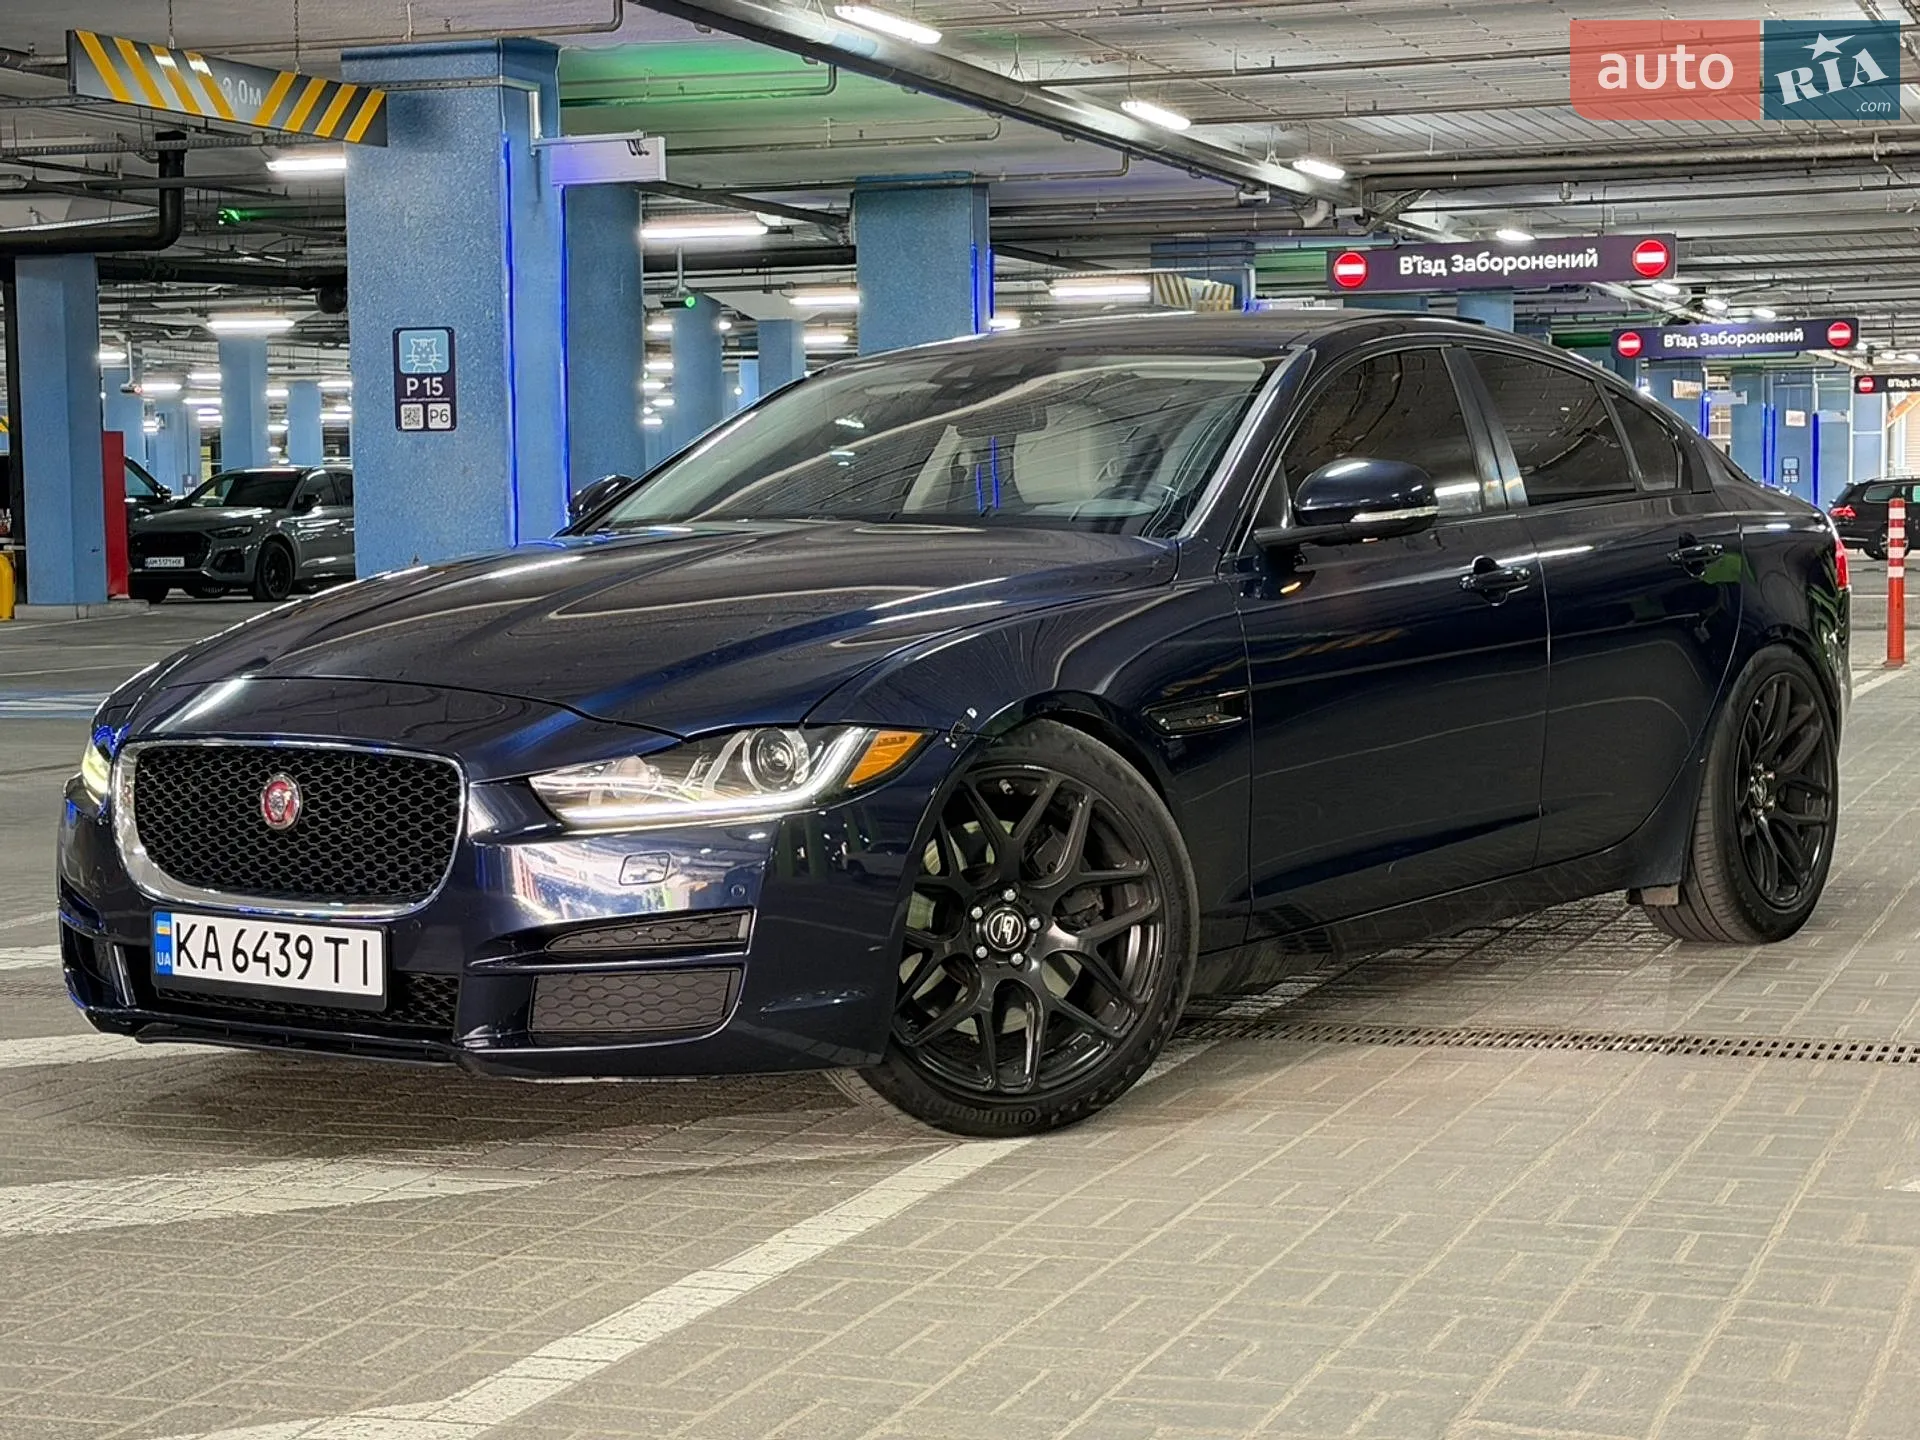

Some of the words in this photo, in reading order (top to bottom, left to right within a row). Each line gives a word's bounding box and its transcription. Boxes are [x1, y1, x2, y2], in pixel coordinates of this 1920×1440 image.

[1451, 248, 1599, 277] Заборонений
[1700, 328, 1804, 348] Заборонений
[429, 408, 449, 424] P6
[157, 951, 171, 967] UA
